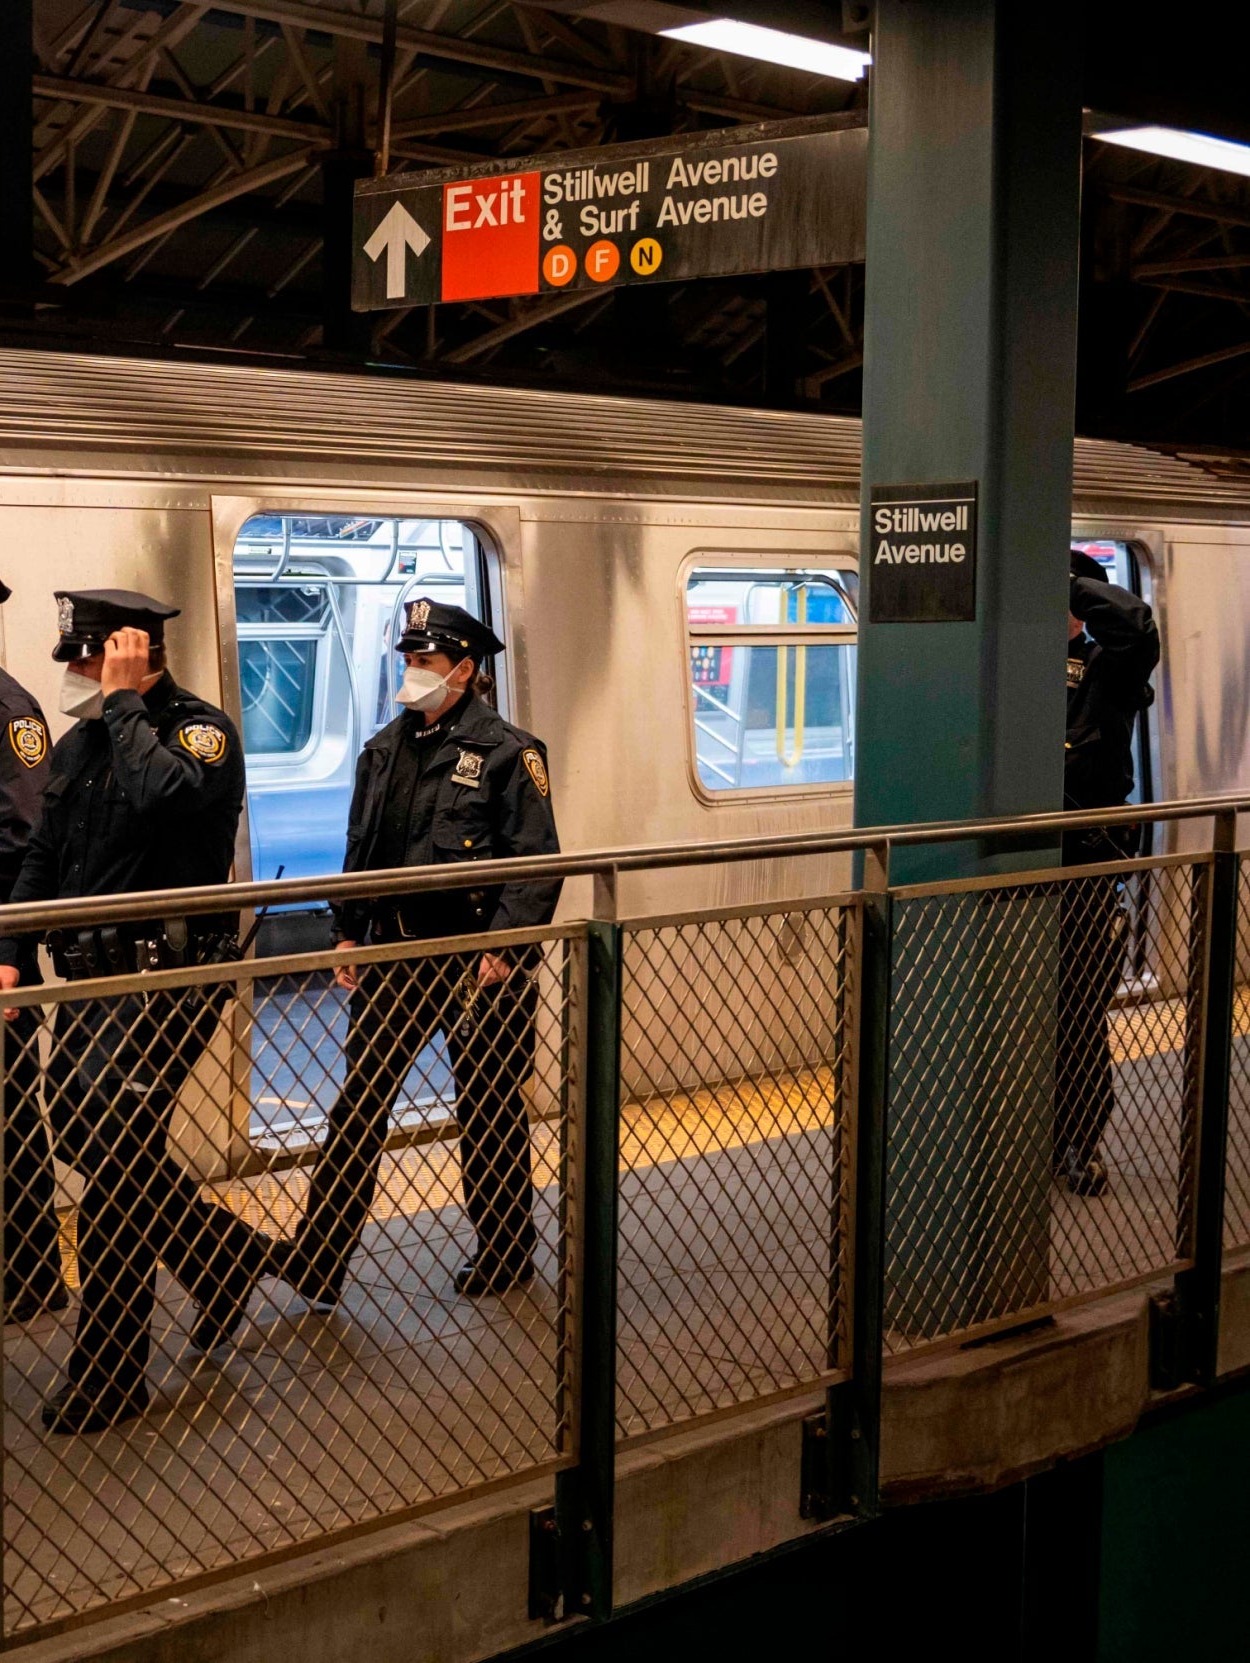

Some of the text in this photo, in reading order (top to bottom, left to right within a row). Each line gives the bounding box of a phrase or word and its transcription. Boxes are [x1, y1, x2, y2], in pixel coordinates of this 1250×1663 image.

[544, 152, 778, 204] Stillwell Avenue
[446, 178, 526, 232] Exit
[542, 191, 768, 241] & Surf Avenue
[551, 246, 653, 278] D F N
[874, 505, 968, 534] Stillwell
[874, 540, 966, 565] Avenue
